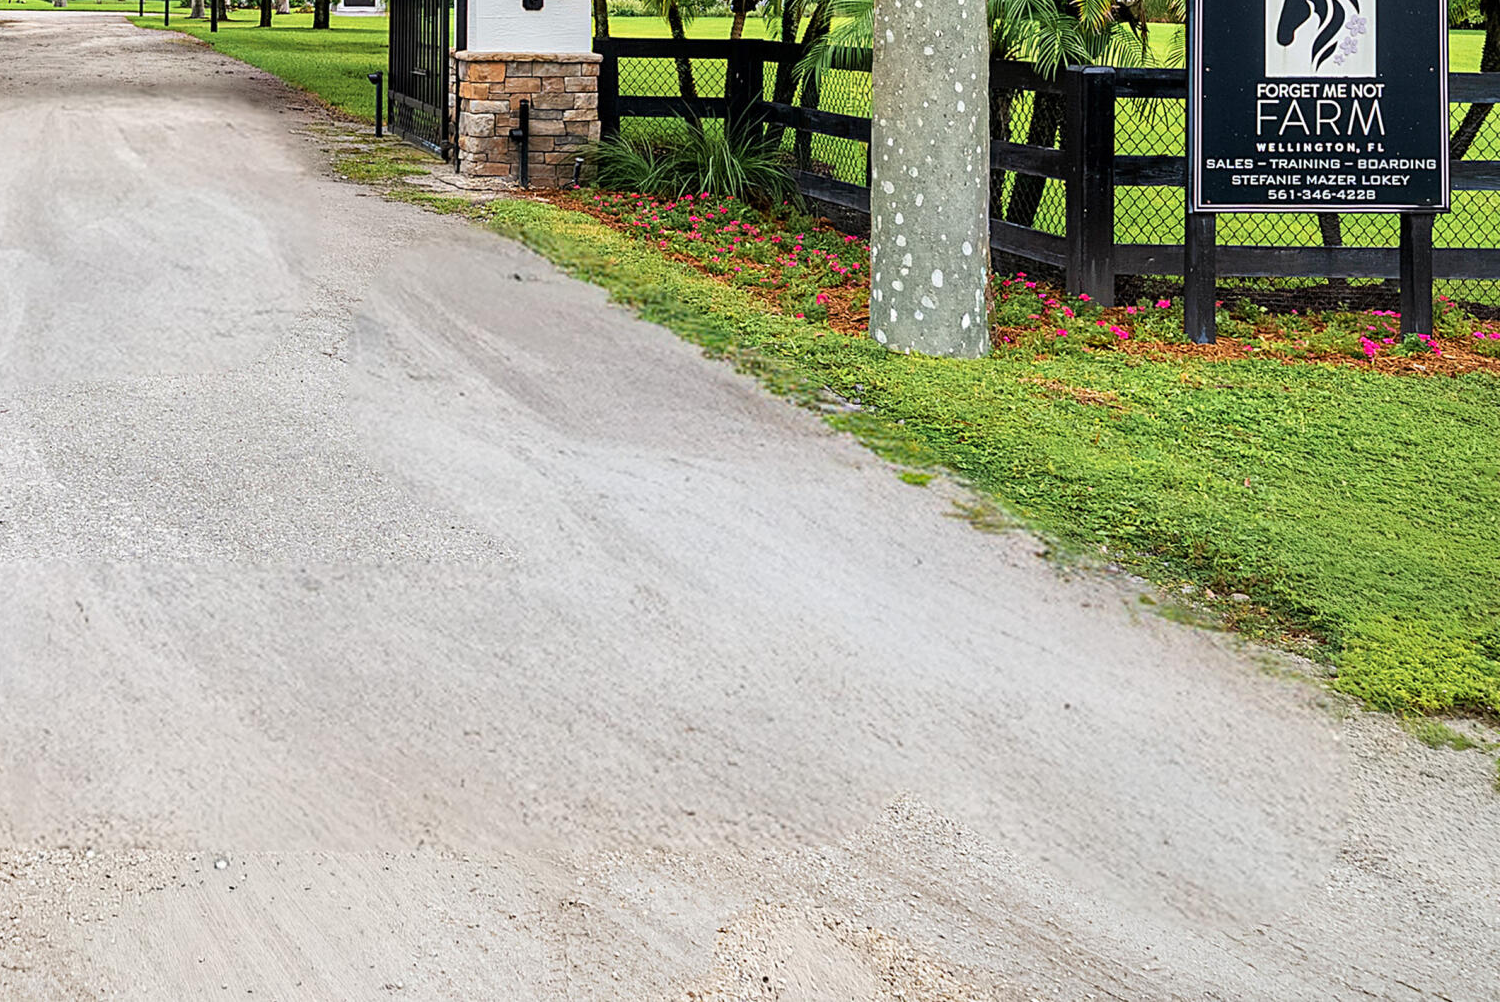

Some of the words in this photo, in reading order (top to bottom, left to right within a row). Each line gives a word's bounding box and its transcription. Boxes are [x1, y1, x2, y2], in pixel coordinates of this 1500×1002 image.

[1257, 83, 1320, 98] FORGET
[1322, 83, 1348, 98] ME
[1351, 83, 1385, 98] NOT
[1256, 99, 1385, 136] FARM
[1256, 142, 1361, 154] WELLINGTON,
[1367, 142, 1385, 153] FL
[1206, 158, 1254, 169] SALES
[1269, 158, 1341, 169] TRAINING
[1357, 158, 1437, 169] BOARDING
[1231, 174, 1302, 186] STEFANIE
[1306, 174, 1357, 186] MAZER
[1361, 174, 1411, 186] LOKEY
[1267, 189, 1376, 200] 561-346-4228
